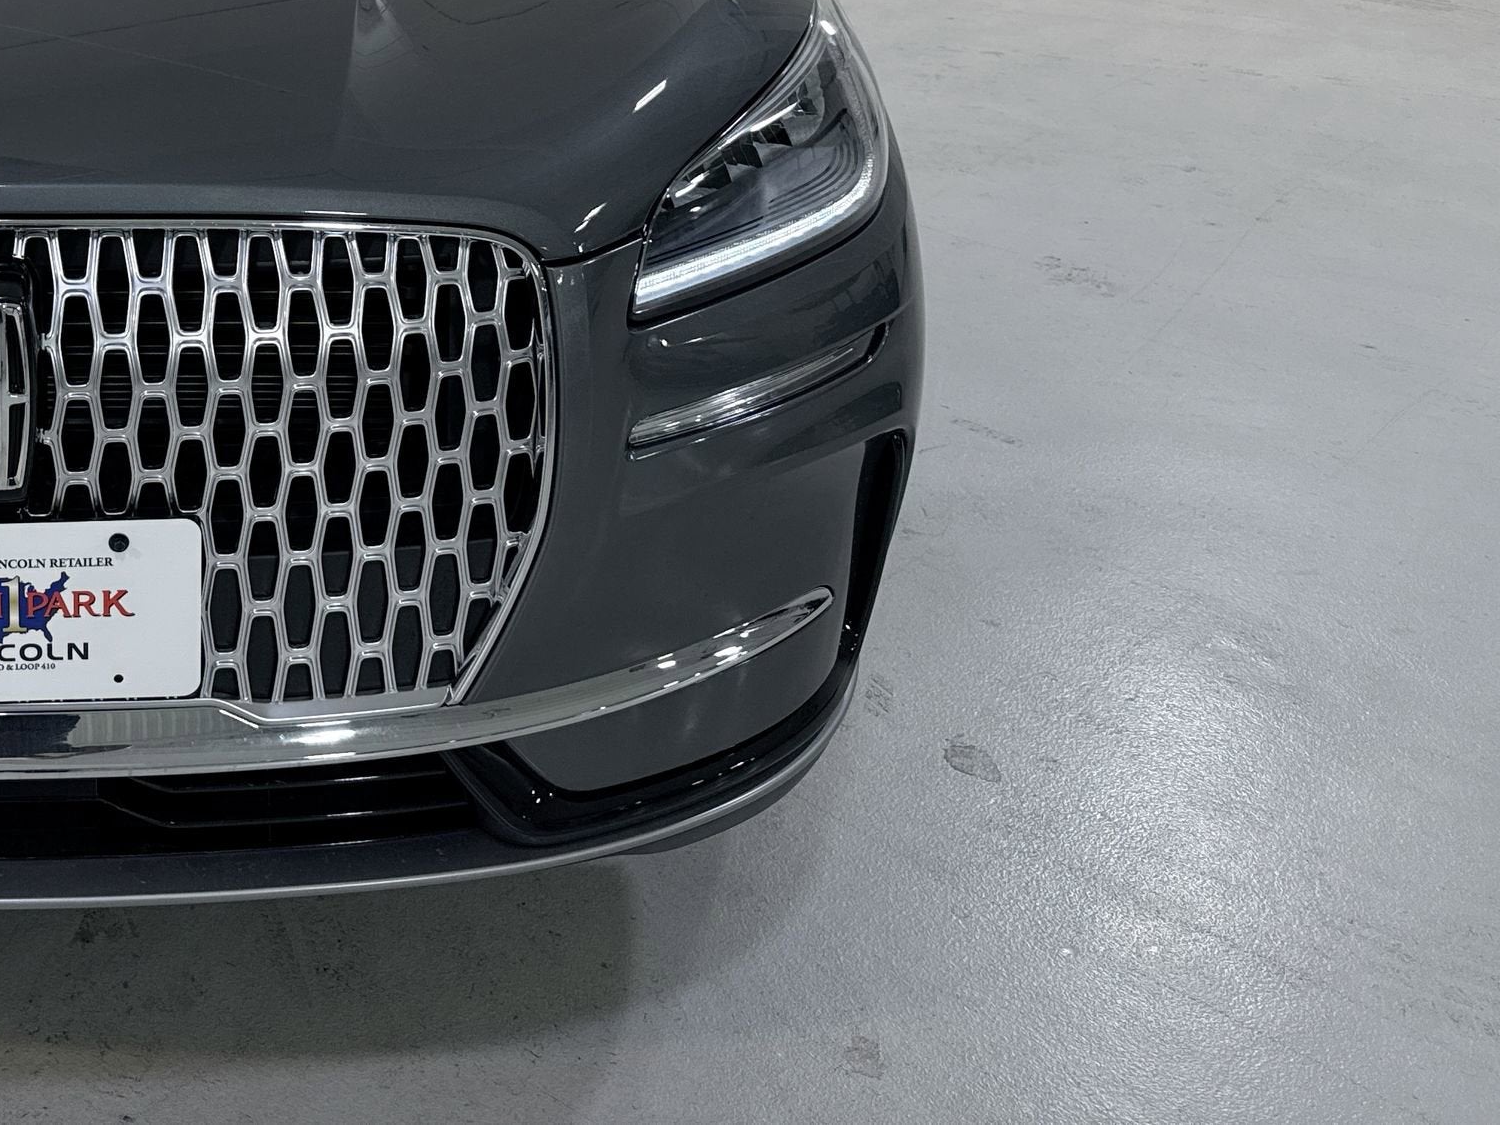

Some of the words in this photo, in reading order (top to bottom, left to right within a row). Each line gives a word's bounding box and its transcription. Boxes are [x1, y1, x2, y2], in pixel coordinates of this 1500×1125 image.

[49, 557, 114, 568] RETAILER
[26, 589, 136, 618] PARK
[15, 663, 40, 671] LOOP
[41, 662, 56, 671] 410
